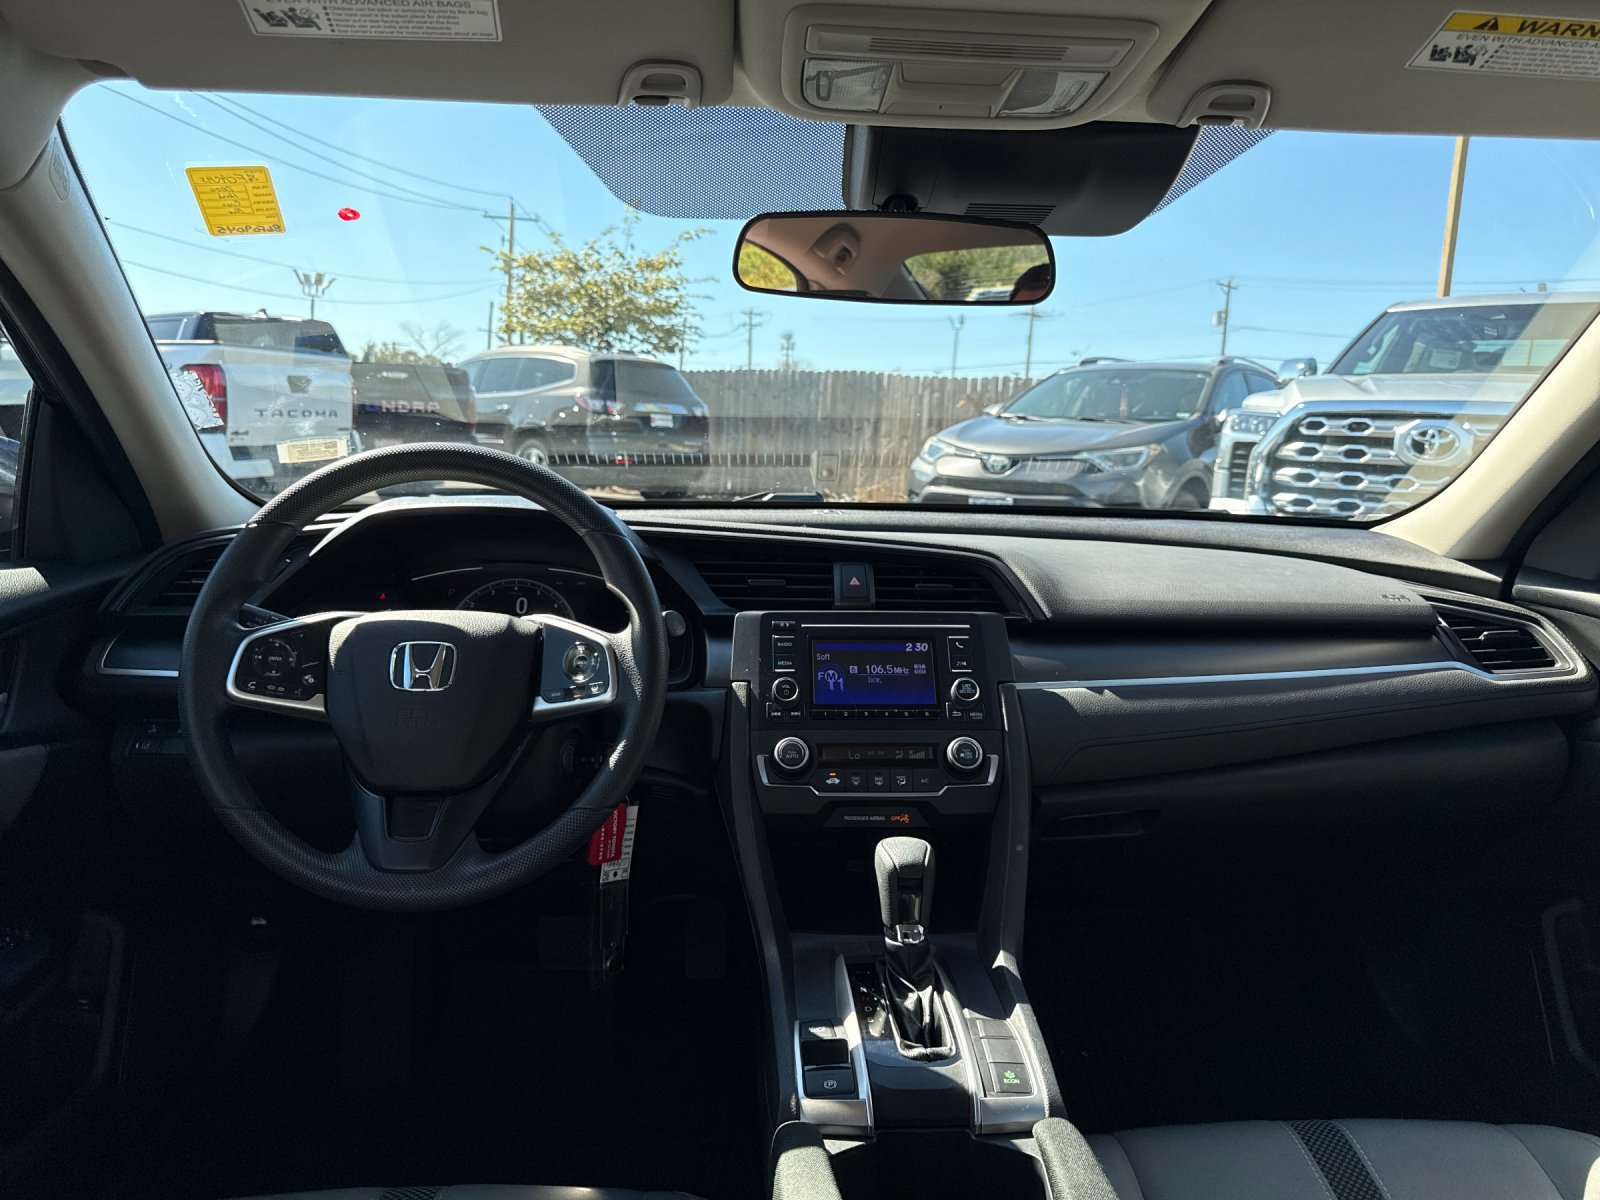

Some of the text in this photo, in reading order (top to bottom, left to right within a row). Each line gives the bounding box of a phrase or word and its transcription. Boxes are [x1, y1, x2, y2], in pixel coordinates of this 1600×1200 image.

[413, 0, 434, 8] AIR
[437, 1, 471, 9] BAGS
[1456, 33, 1489, 42] EVEN
[1492, 35, 1522, 44] WITH
[1523, 37, 1589, 48] ADVANCED
[254, 407, 338, 419] TACOMA
[516, 597, 528, 615] 0
[816, 653, 831, 661] Soft
[848, 750, 861, 760] Lo
